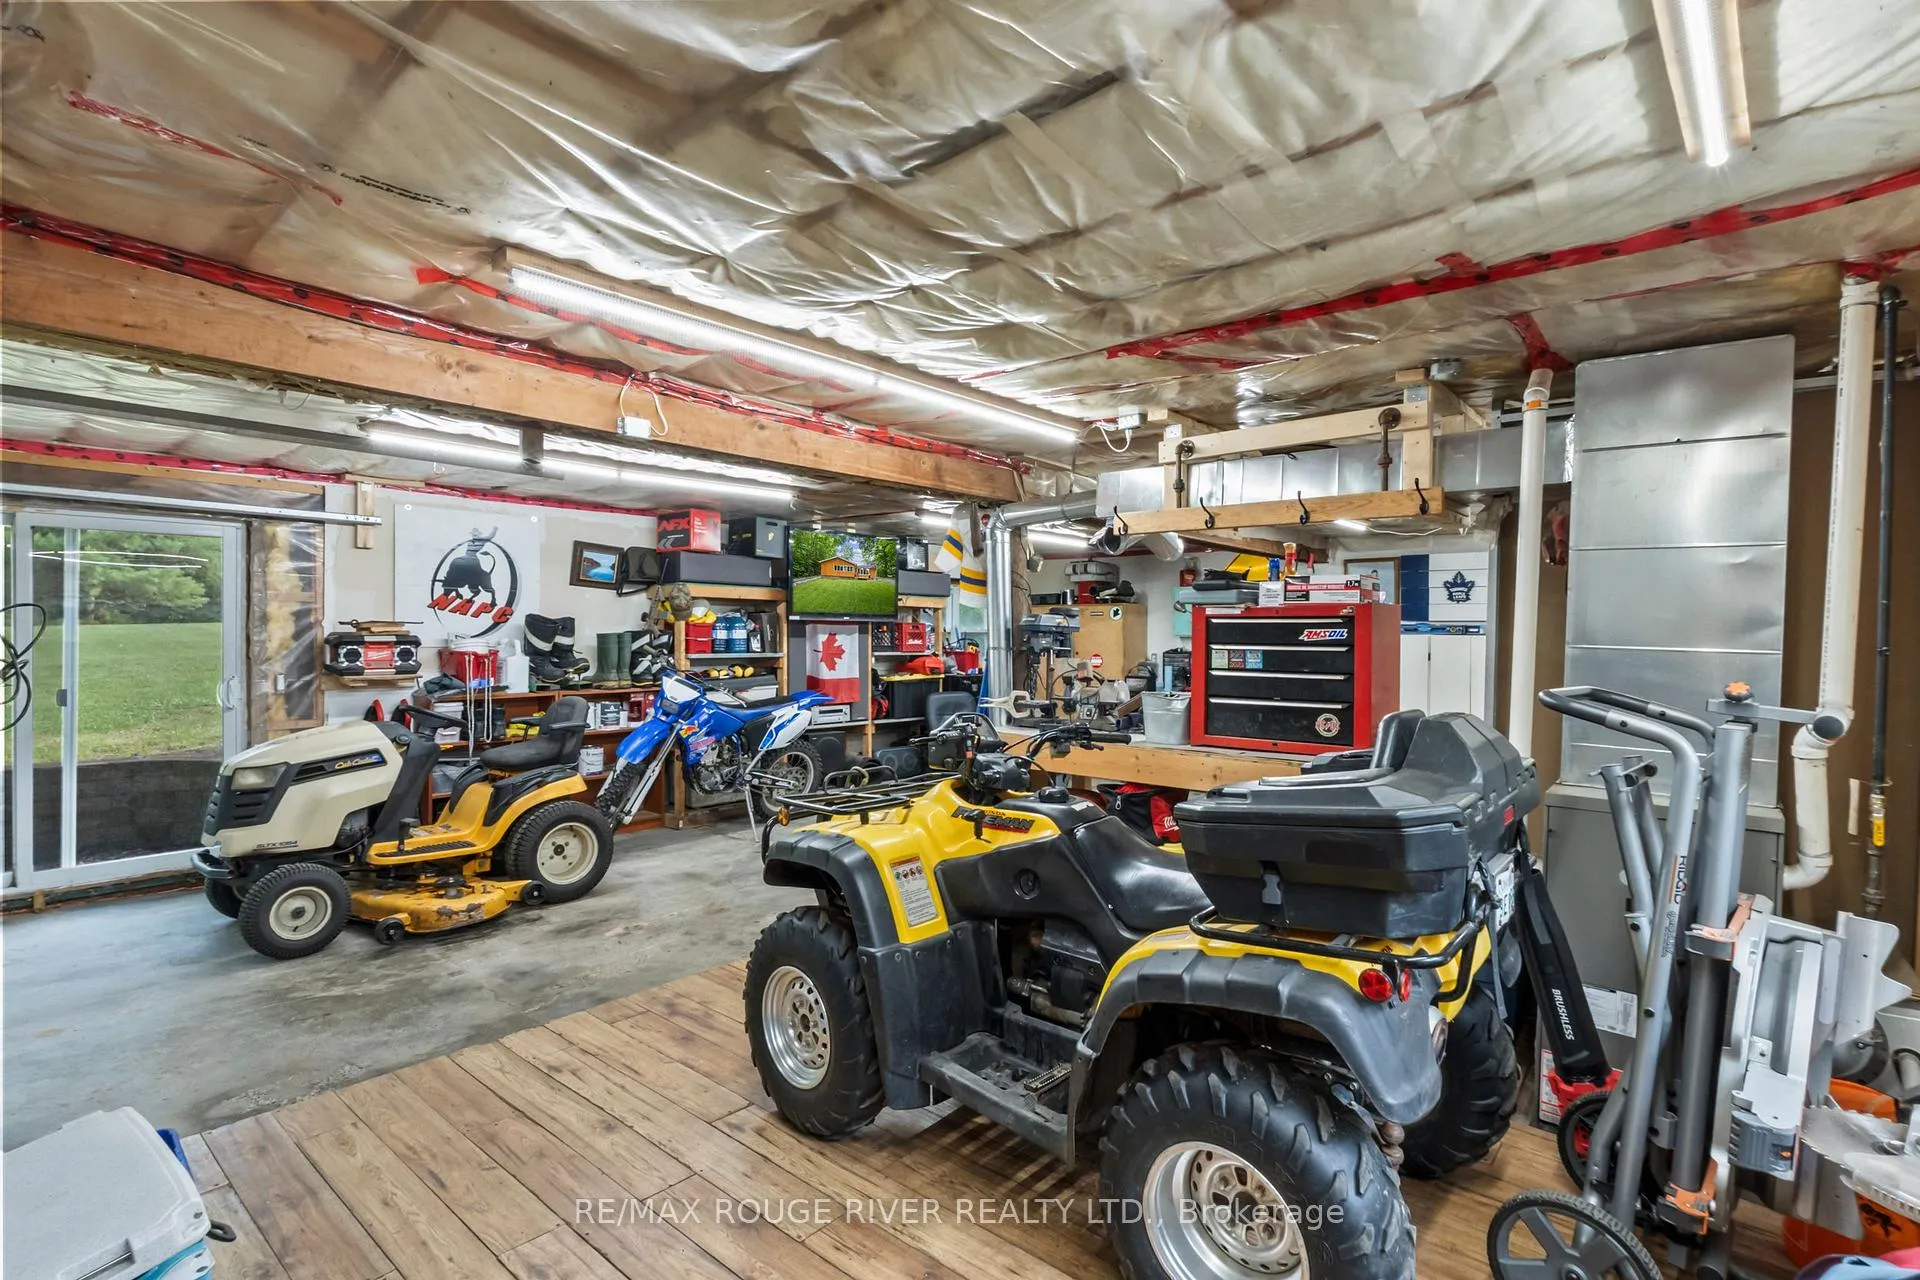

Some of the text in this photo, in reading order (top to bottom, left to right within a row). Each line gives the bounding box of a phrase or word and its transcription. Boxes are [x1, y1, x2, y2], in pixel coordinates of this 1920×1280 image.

[427, 593, 513, 623] NAPC
[1303, 630, 1346, 639] AMSOIL
[951, 806, 1035, 829] FEMAN
[1552, 988, 1575, 1040] BRUSHLESS
